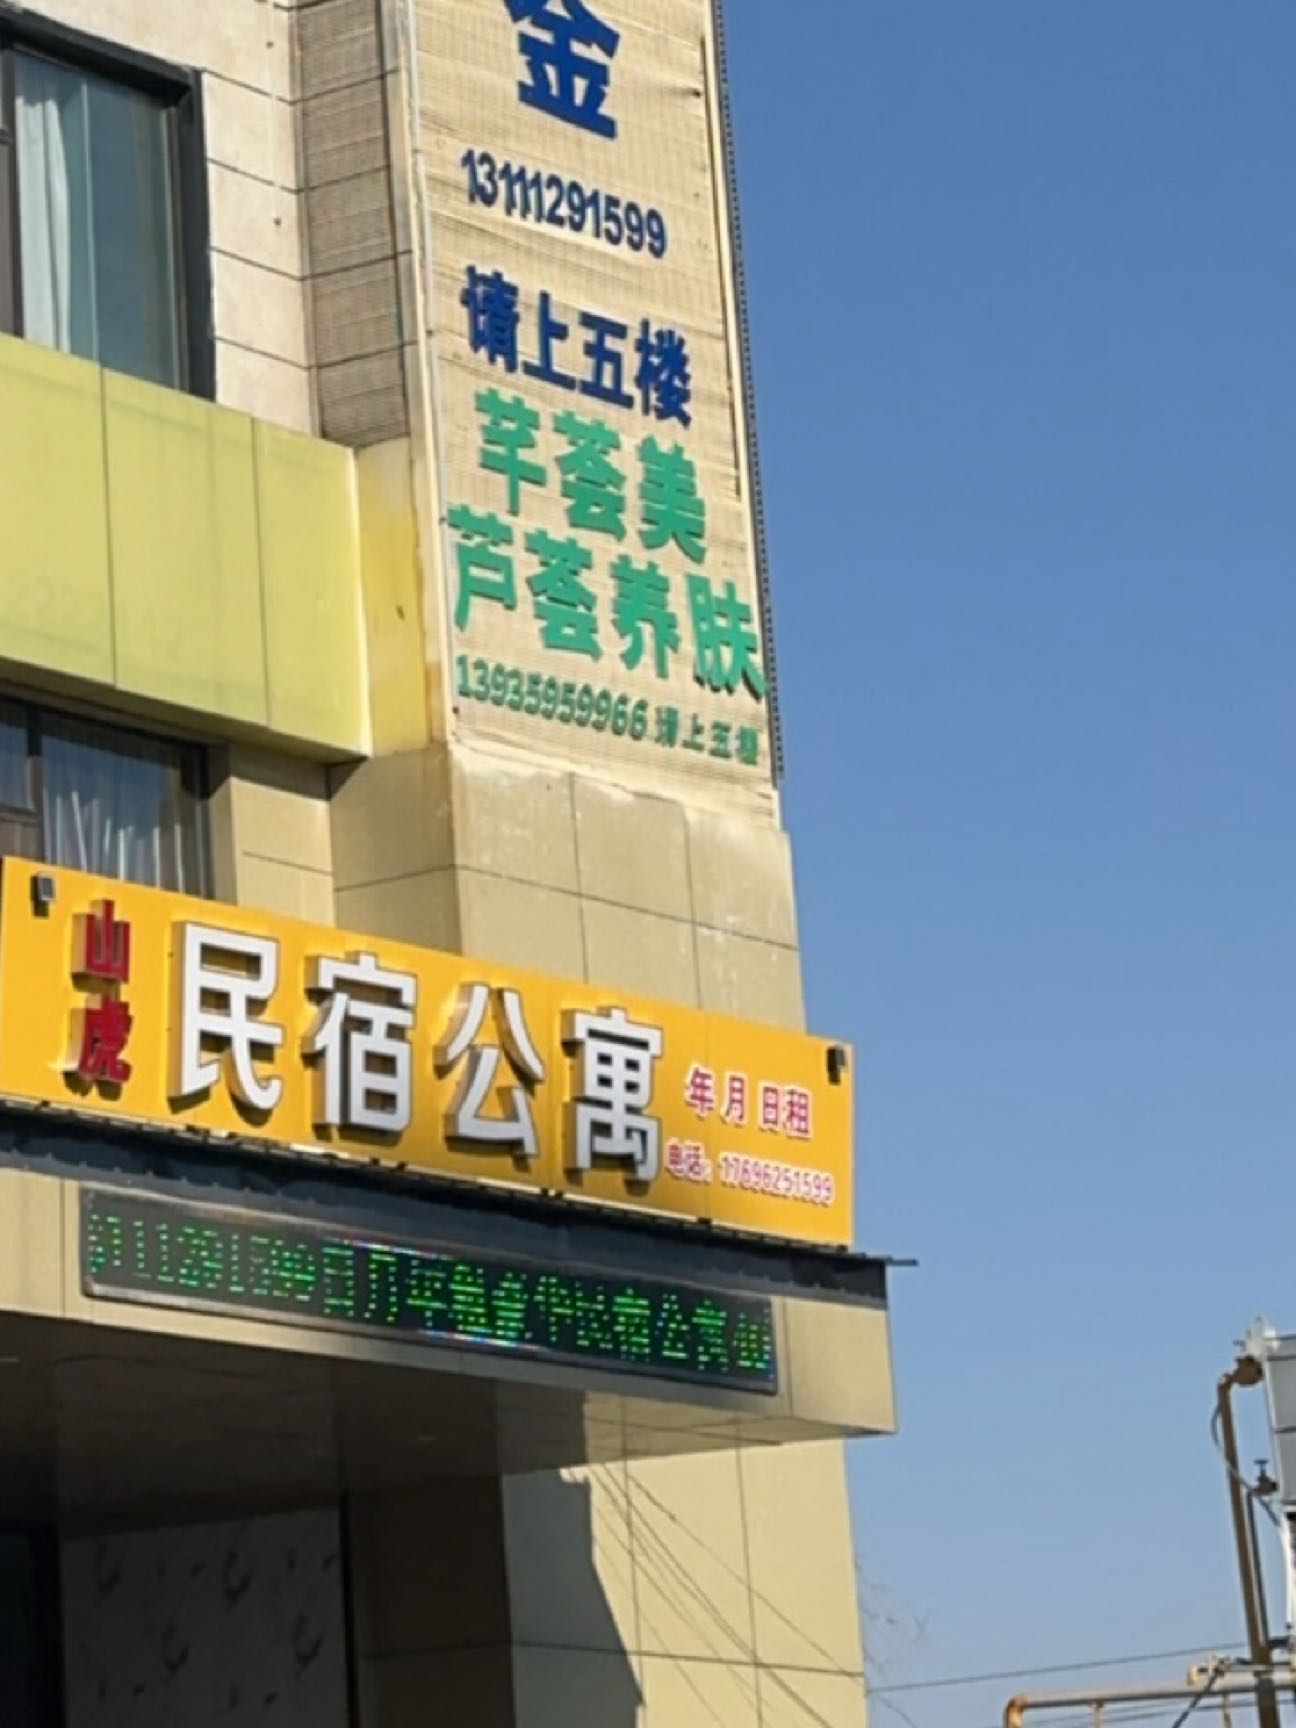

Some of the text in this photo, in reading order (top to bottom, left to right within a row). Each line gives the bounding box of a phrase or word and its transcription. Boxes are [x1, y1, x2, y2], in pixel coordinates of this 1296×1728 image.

[461, 149, 667, 258] 13111291599
[460, 265, 692, 430] 请上五楼
[474, 386, 708, 564] 芊荟美
[447, 502, 768, 702] 芦荟养肤
[455, 653, 650, 741] 13935959966
[72, 899, 133, 1084] 山虎
[172, 921, 664, 1181] 民宿公寓
